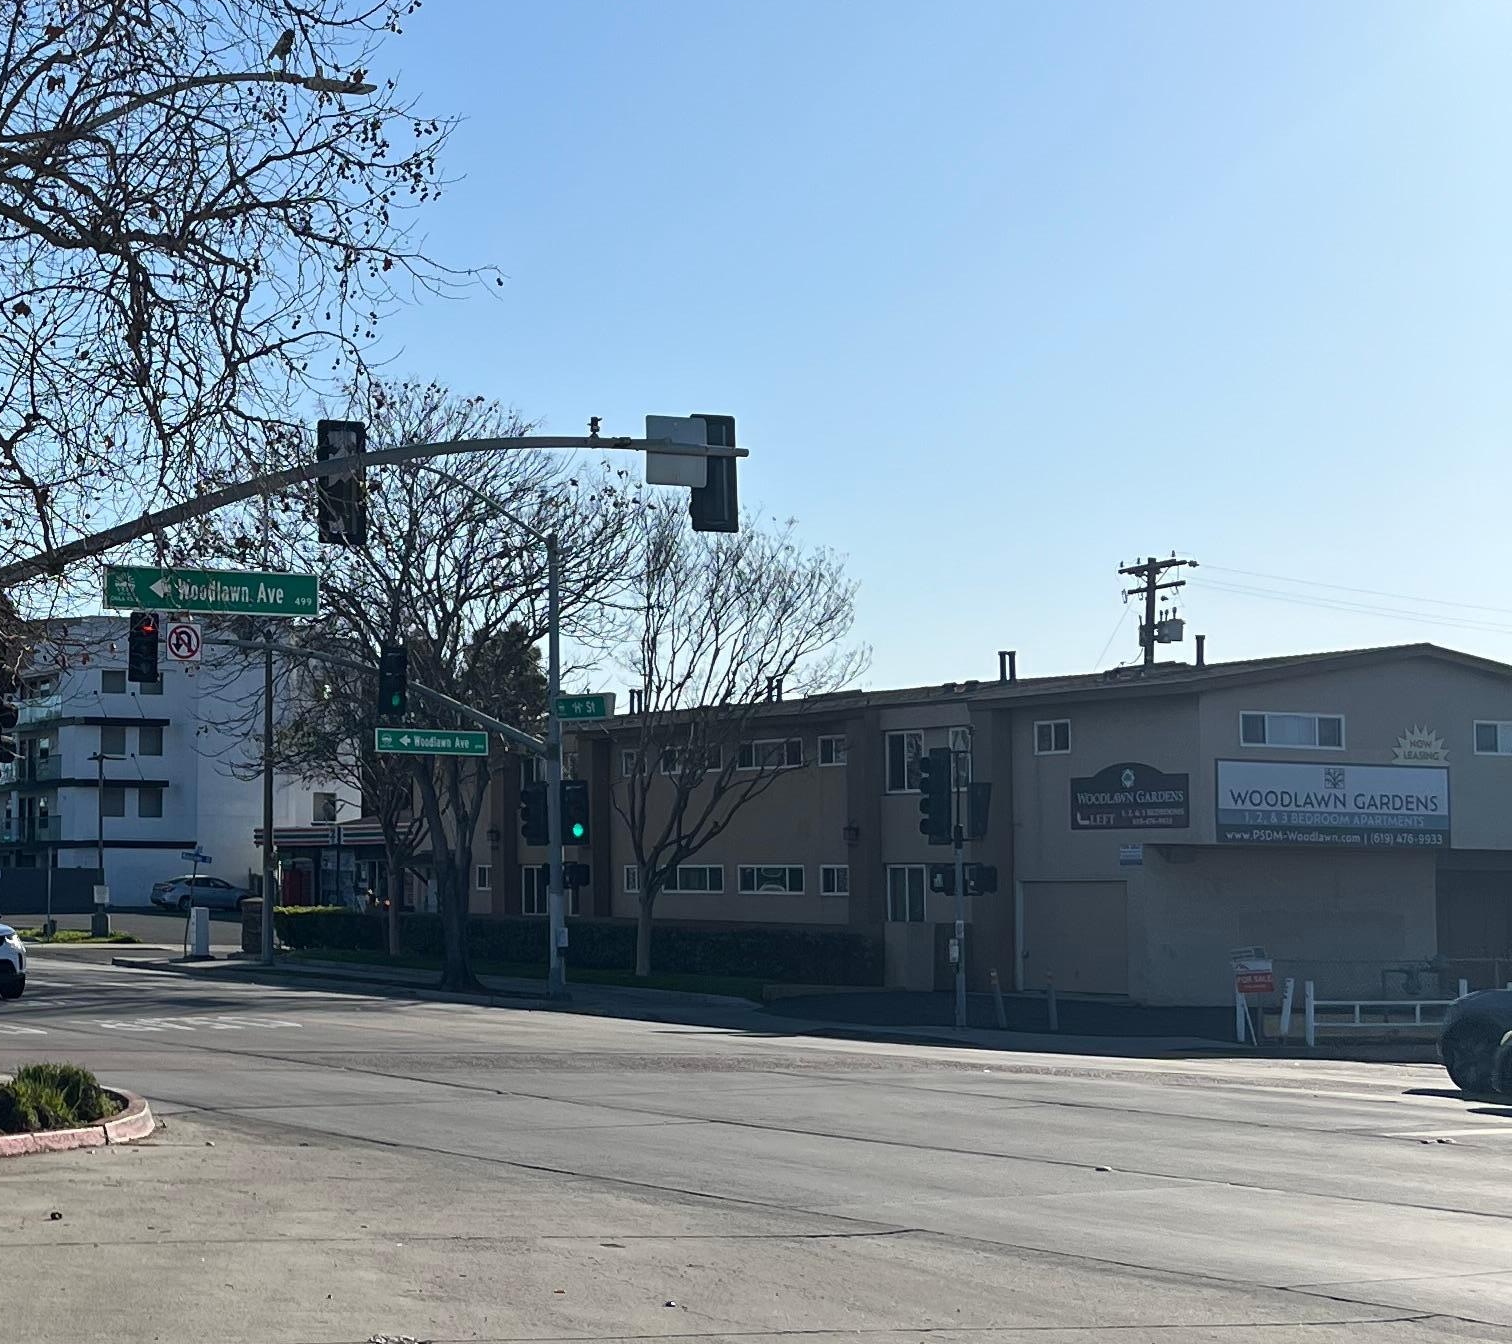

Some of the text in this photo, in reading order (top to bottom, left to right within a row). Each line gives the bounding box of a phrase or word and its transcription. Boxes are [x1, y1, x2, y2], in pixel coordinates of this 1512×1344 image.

[178, 578, 284, 604] Woodlawn Ave
[294, 597, 312, 607] 499
[585, 700, 596, 713] St
[413, 734, 452, 748] Woodlawn
[454, 736, 470, 749] Ave
[1409, 739, 1433, 749] NOW
[1402, 750, 1440, 761] LEASING
[1077, 790, 1184, 805] WOODLAWN GARDENS
[1229, 789, 1438, 812] WOODLAWN GARDENS
[1089, 814, 1115, 825] LEFT
[1256, 813, 1267, 825] 2,
[1270, 813, 1278, 824] &
[1281, 813, 1288, 824] 3
[1291, 813, 1352, 825] BEDROOM
[1353, 815, 1424, 826] APARTMENTS
[1226, 829, 1361, 843] www.PSDM-Woodlawn.com
[1370, 832, 1393, 845] (619)
[1396, 833, 1443, 845] 476-9933
